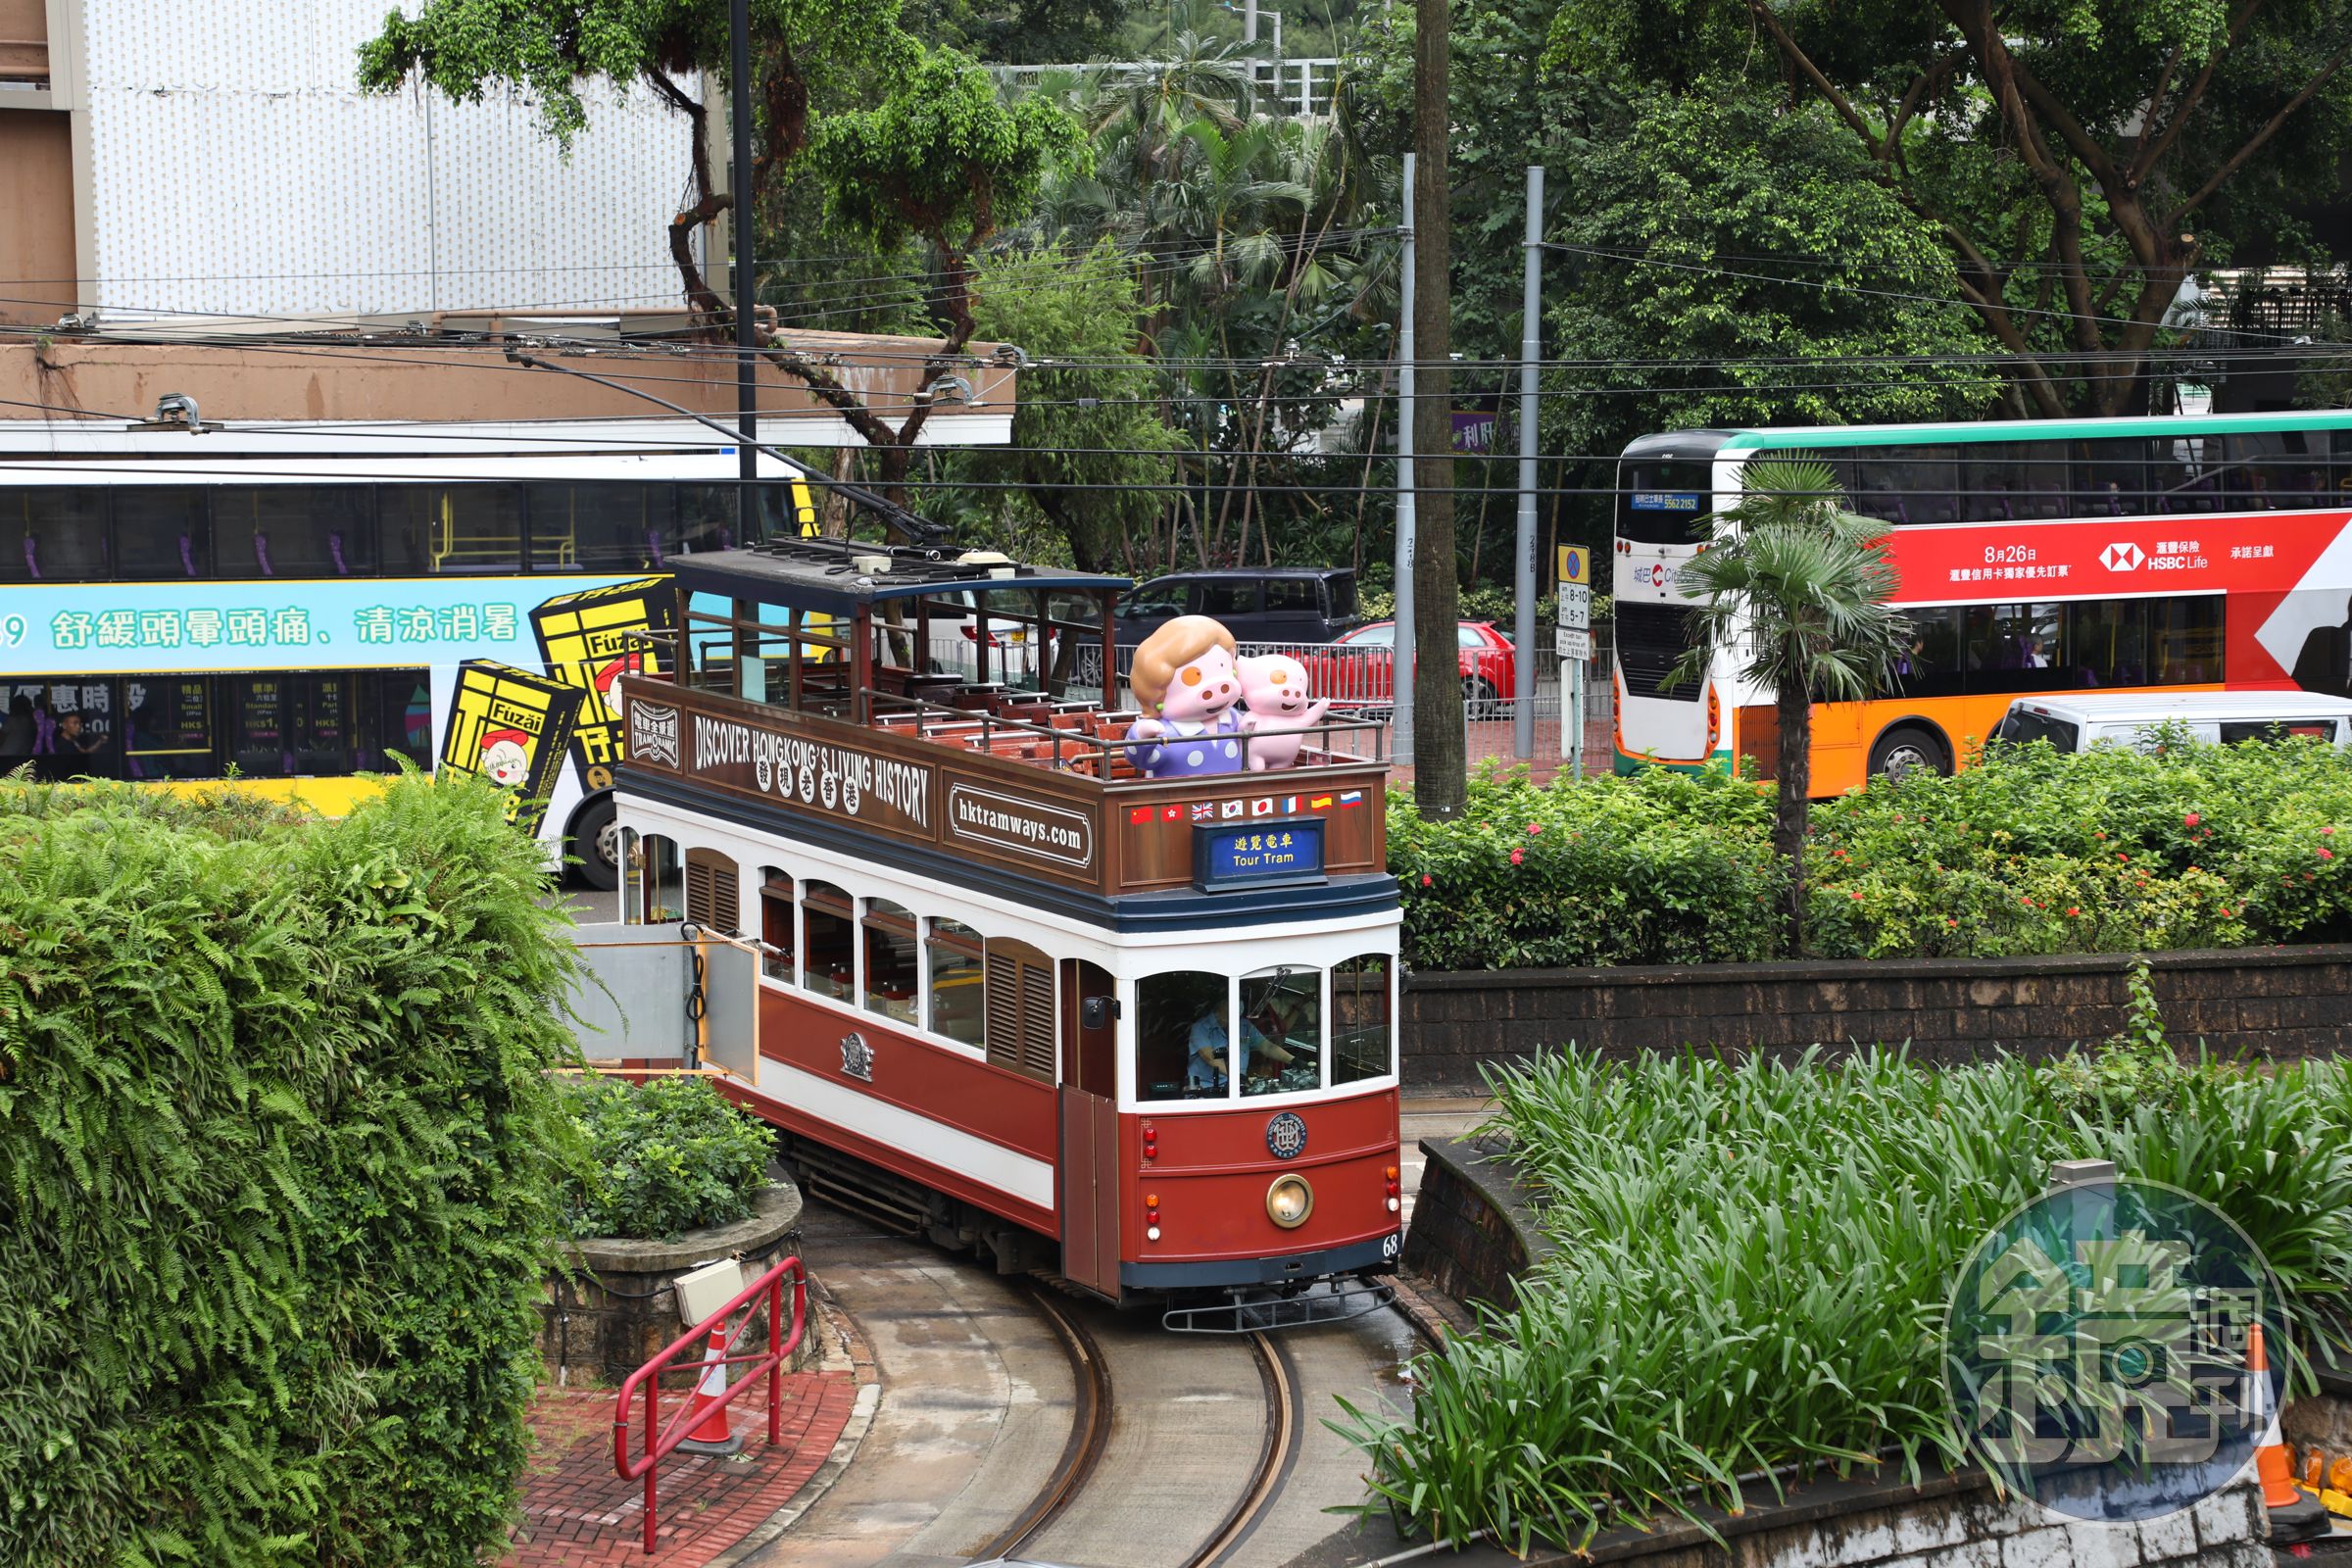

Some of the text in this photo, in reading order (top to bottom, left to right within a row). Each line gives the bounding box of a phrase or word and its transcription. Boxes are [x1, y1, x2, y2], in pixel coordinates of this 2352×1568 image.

[1664, 498, 1680, 510] 5562
[1681, 498, 1695, 510] 2152
[1984, 545, 2036, 564] 8月26日
[2147, 555, 2208, 570] HSBC Life
[1634, 566, 1651, 584] 城巴
[0, 612, 27, 649] 9
[695, 715, 750, 770] DISCOVER
[830, 748, 872, 793] LIVING
[874, 759, 928, 829] HISTORY
[758, 760, 858, 808] 發現老香港
[958, 798, 1081, 851] hktramways.com
[1234, 832, 1294, 852] 遊覽電車
[1233, 852, 1294, 866] Tour Tram
[1382, 1234, 1398, 1258] 68
